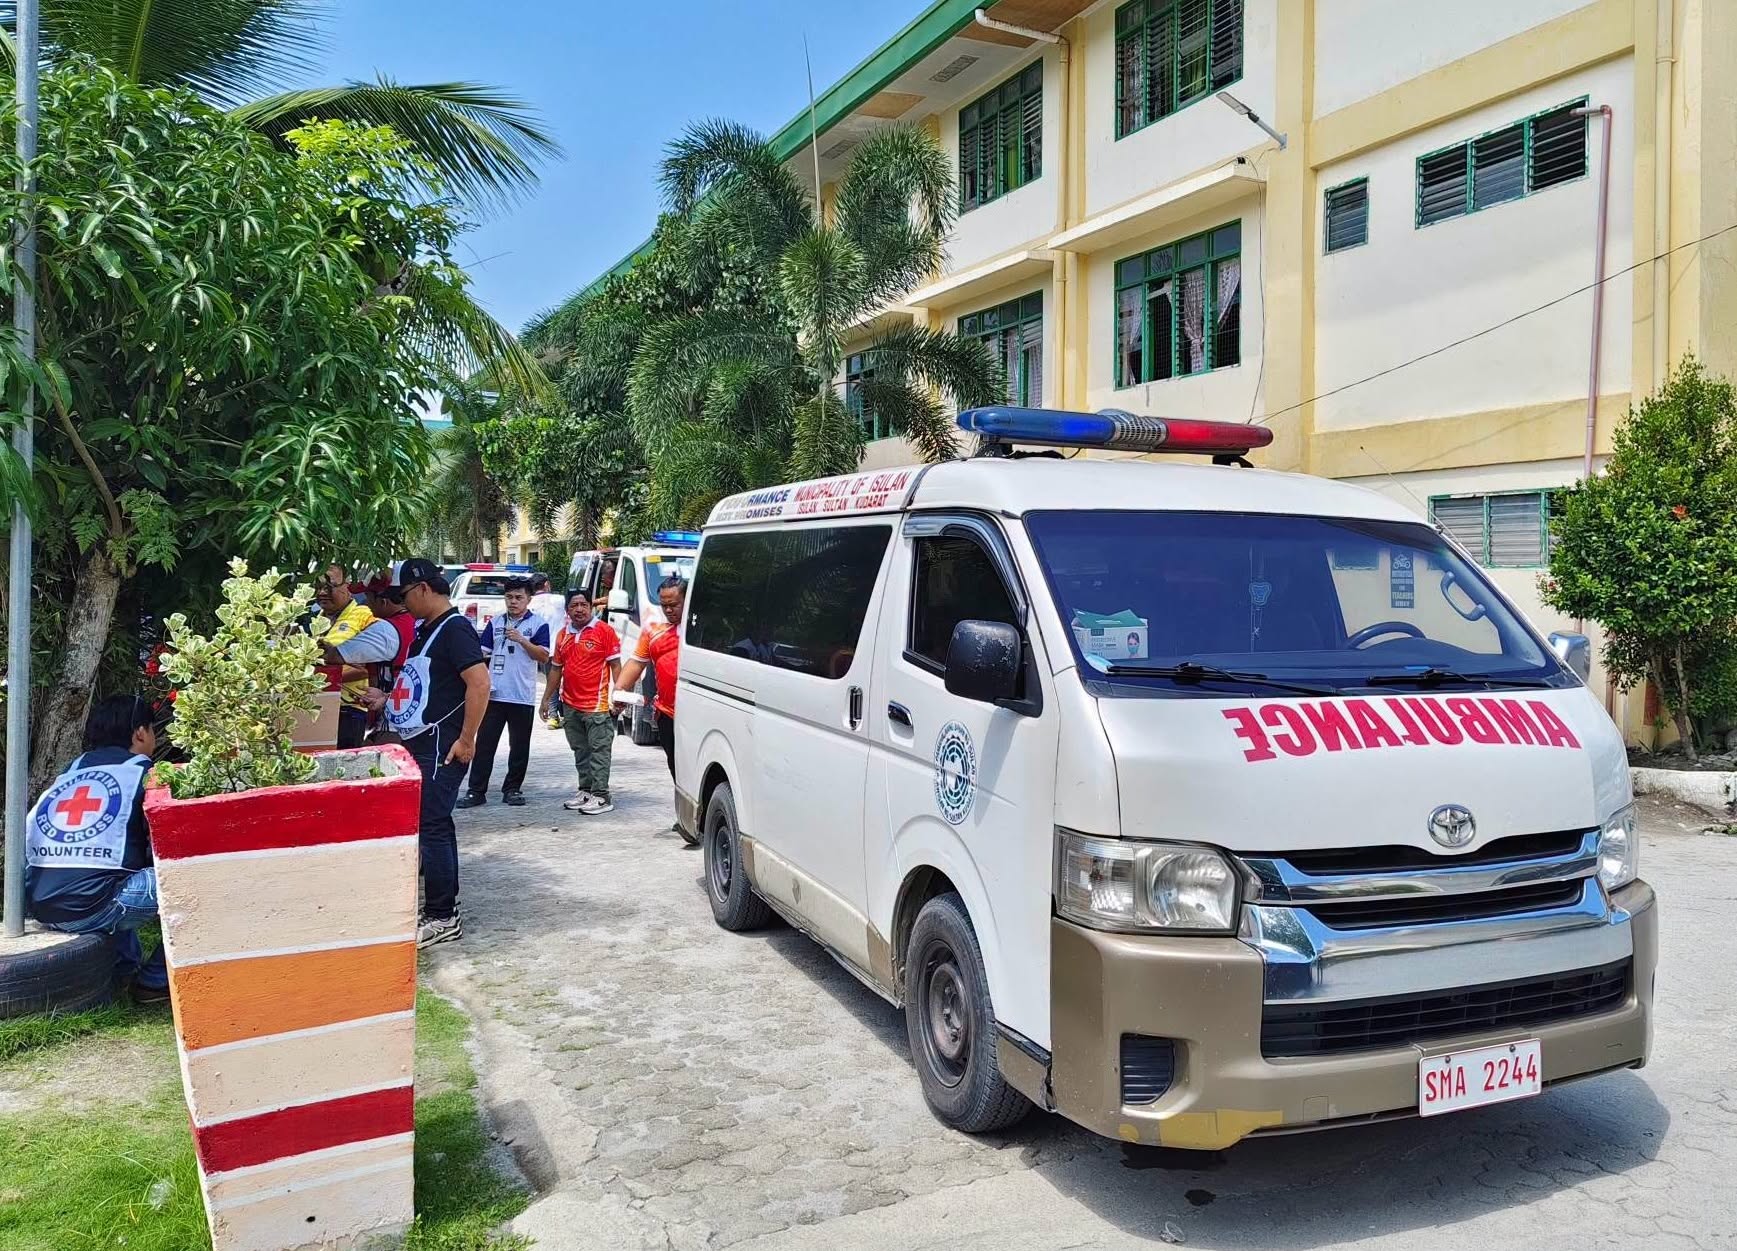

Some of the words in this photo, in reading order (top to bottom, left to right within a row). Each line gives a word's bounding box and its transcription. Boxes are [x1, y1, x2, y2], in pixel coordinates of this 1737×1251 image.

[794, 479, 850, 501] MUNICIPALITY
[851, 476, 869, 495] OF
[868, 471, 912, 492] ISULAN
[823, 497, 849, 512] SULTAN
[394, 700, 419, 724] CROSS
[50, 771, 120, 799] PHILIPPINE
[37, 814, 57, 838] RED
[63, 813, 114, 843] CROSS
[32, 847, 112, 859] VOLUNTEER
[1425, 1066, 1466, 1102] SMA
[1483, 1053, 1537, 1091] 2244
